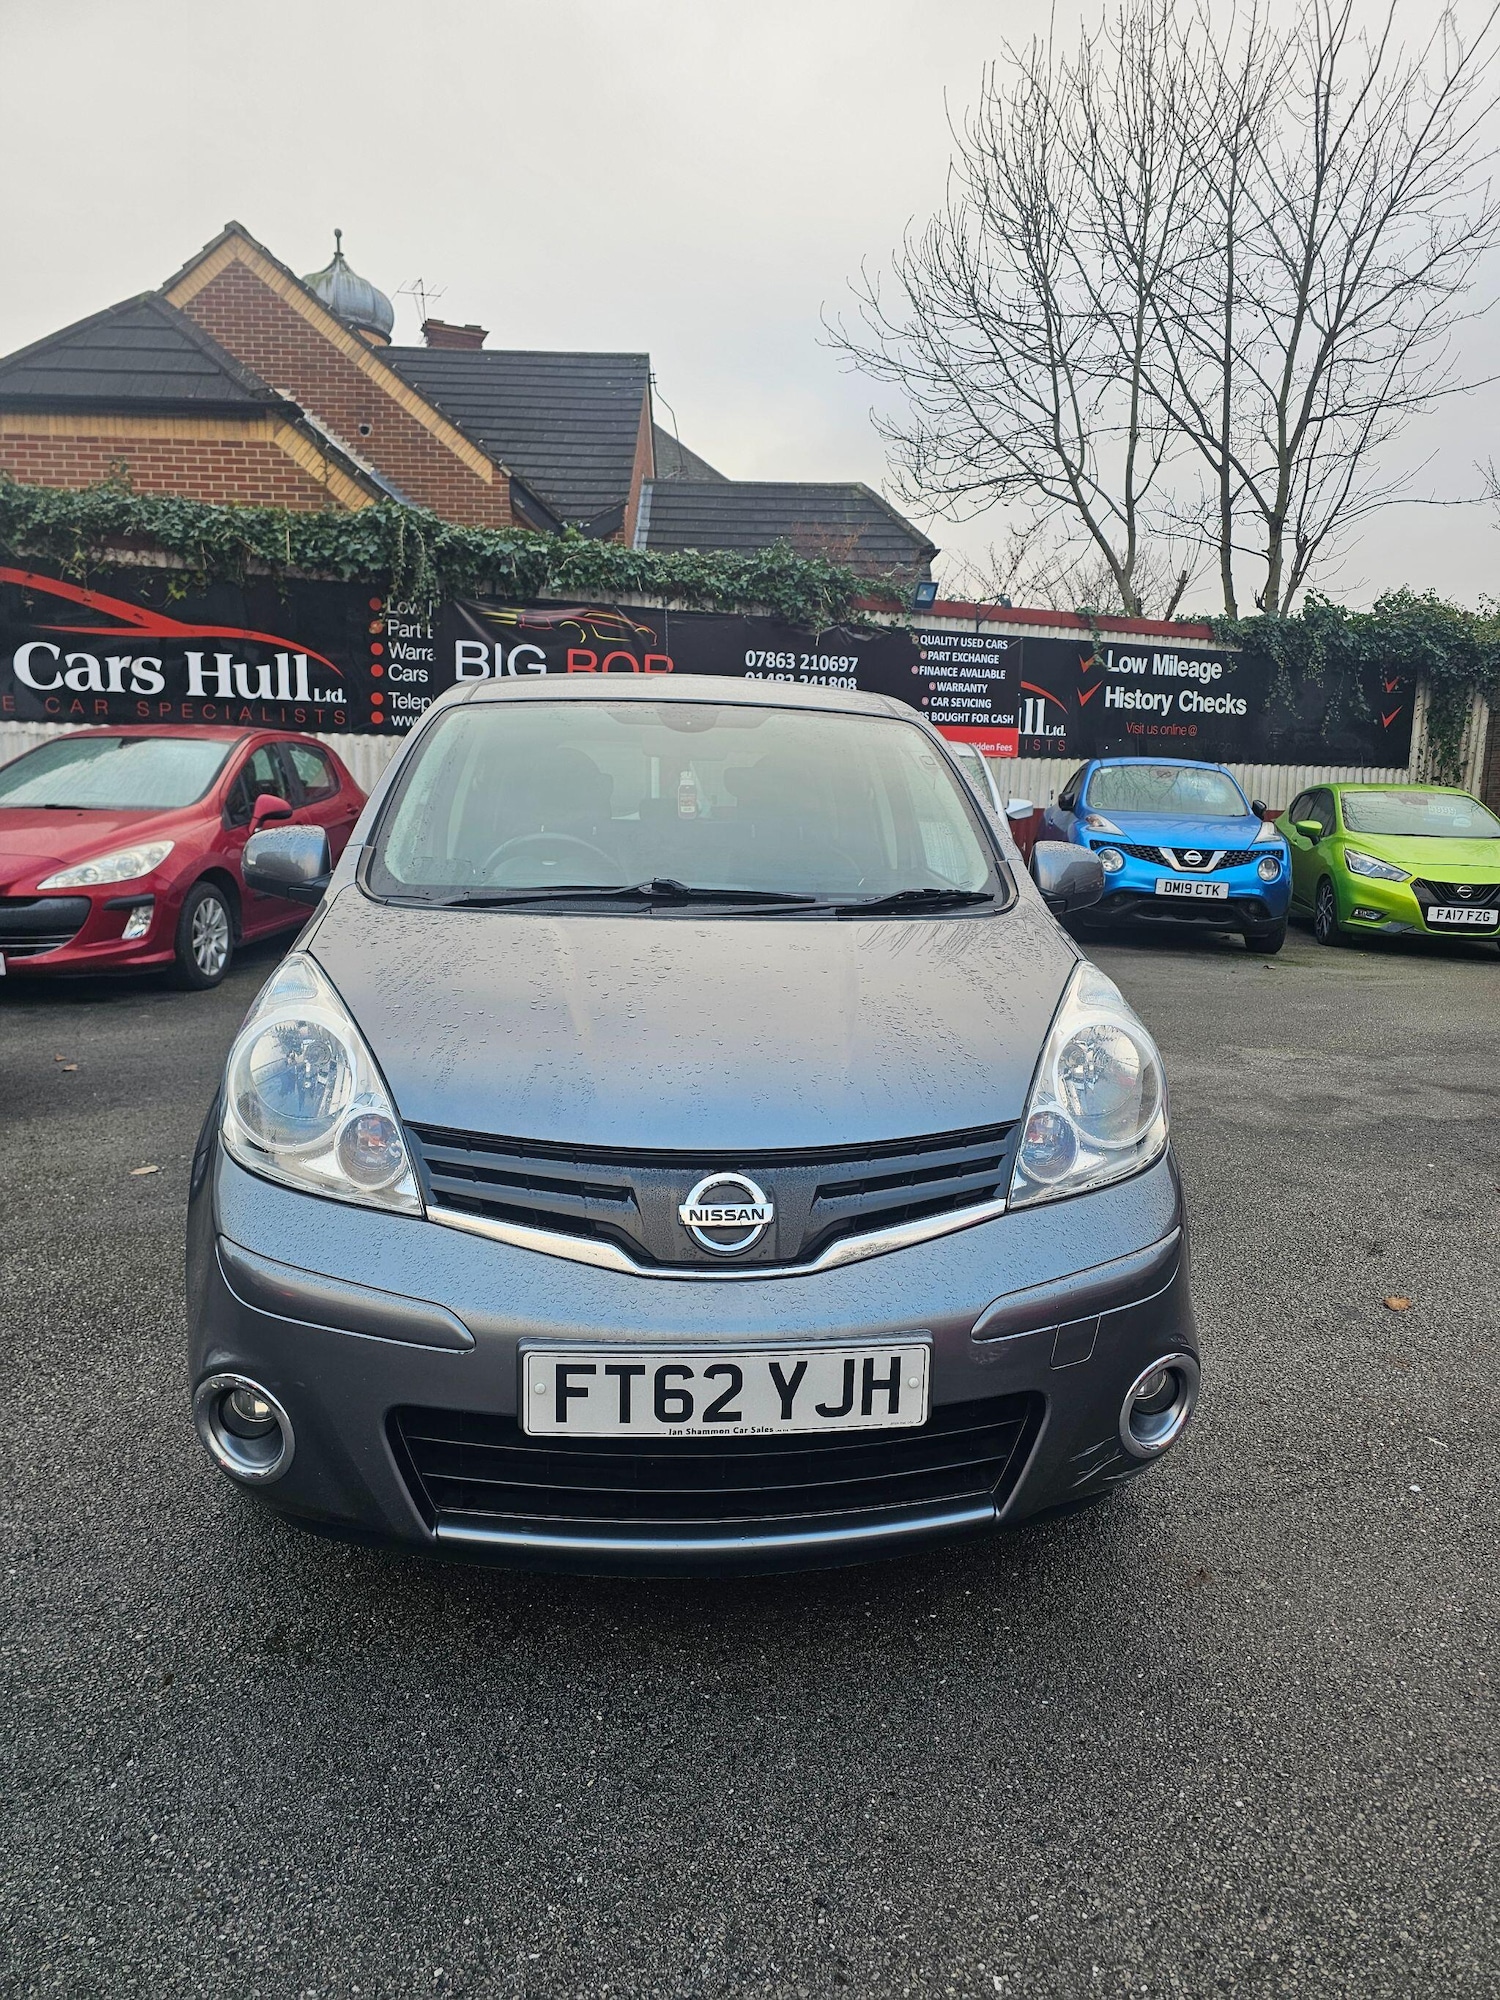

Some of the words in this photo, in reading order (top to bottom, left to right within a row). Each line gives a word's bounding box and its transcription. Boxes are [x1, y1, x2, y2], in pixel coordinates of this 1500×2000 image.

[387, 619, 422, 639] Part
[920, 634, 959, 647] QUALITY
[960, 637, 984, 648] USED
[985, 639, 1009, 650] CARS
[455, 639, 548, 682] BIG
[745, 650, 796, 669] 07863
[800, 654, 859, 673] 210697
[927, 650, 950, 662] PART
[951, 652, 1000, 665] EXCHANGE
[13, 641, 166, 695] Cars
[184, 651, 312, 702] Hull
[313, 688, 348, 704] Ltd.
[387, 663, 429, 683] Cars
[918, 665, 958, 678] FINANCE
[959, 667, 1006, 680] AVALIABLE
[1107, 649, 1148, 675] Low
[1152, 653, 1223, 685] Mileage
[936, 681, 988, 694] WARRANTY
[387, 691, 435, 713] Telep
[930, 696, 949, 707] CAR
[950, 697, 992, 709] SEVICING
[1105, 685, 1173, 717] History
[1178, 690, 1248, 716] Checks
[45, 696, 109, 716] CAR
[136, 700, 347, 725] SPECIALISTS
[931, 711, 969, 723] BOUGHT
[971, 712, 989, 724] FOR
[991, 713, 1014, 725] CASH
[1017, 697, 1046, 735] ll
[1046, 725, 1067, 737] Ltd.
[1126, 721, 1145, 735] Visit
[1147, 725, 1158, 736] us
[996, 743, 1013, 752] Fees
[1164, 881, 1192, 894] DM19
[1195, 884, 1220, 896] CTK
[1437, 908, 1463, 921] FA17
[1467, 910, 1490, 922] FZG
[689, 1207, 766, 1223] NISSAN
[555, 1363, 743, 1424] FT62
[768, 1356, 902, 1420] YJH
[733, 1426, 748, 1434] Car
[750, 1425, 774, 1434] Sales
